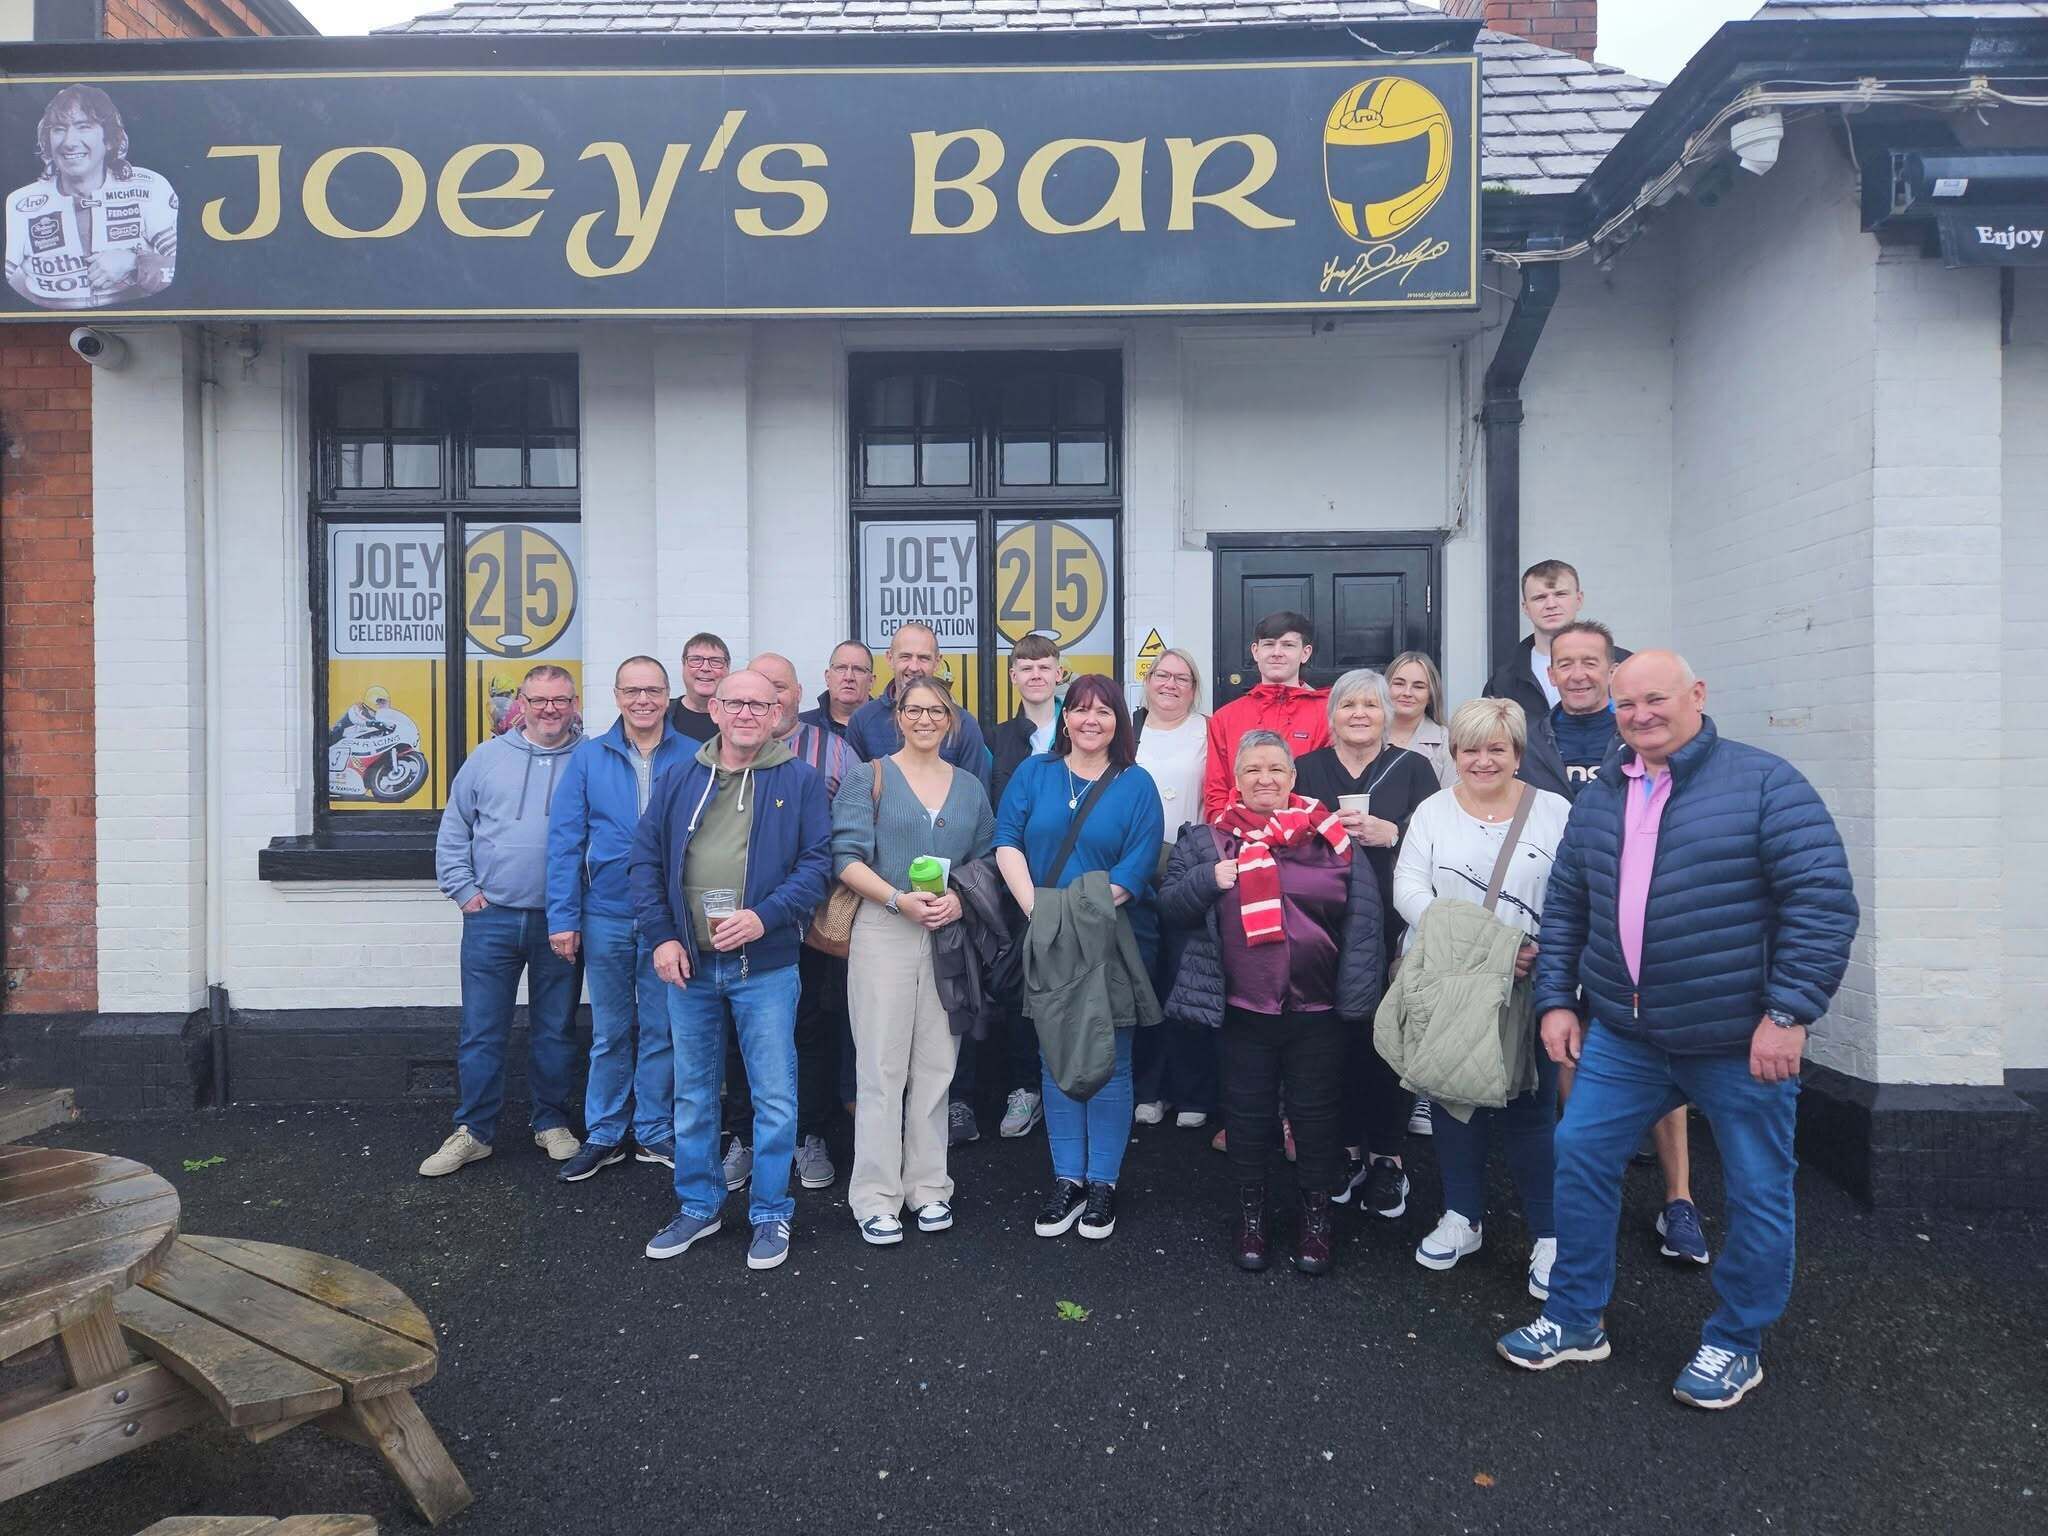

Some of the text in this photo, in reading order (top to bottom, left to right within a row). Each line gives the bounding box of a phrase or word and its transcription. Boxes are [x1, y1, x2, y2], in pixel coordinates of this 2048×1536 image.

[105, 188, 150, 200] MICHELIN
[1976, 226, 2045, 250] Enjoy
[349, 542, 445, 589] JOEY
[880, 536, 976, 584] JOEY
[349, 591, 443, 622] DUNLOP
[880, 586, 973, 616] DUNLOP
[349, 624, 445, 642] CELEBRATION
